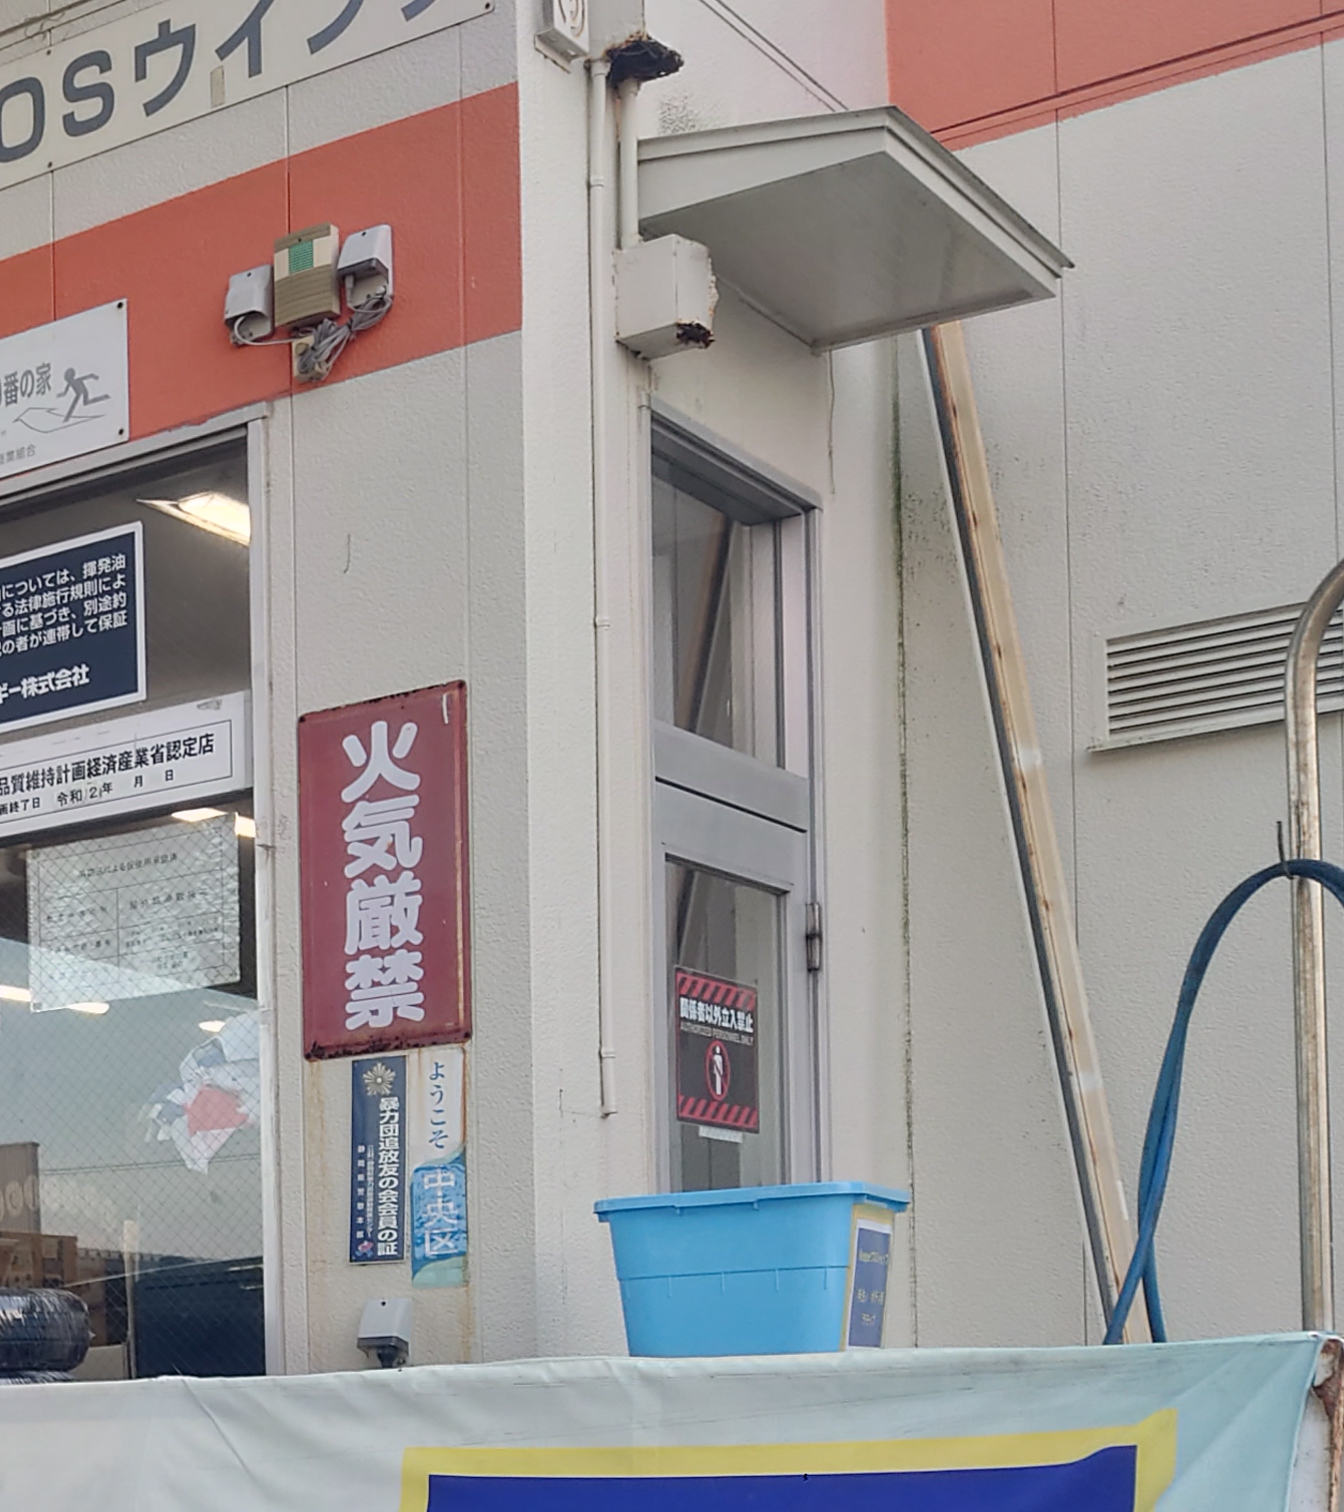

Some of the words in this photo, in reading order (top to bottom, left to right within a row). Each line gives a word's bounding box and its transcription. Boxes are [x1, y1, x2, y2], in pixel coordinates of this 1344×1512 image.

[340, 719, 425, 1032] 火気厳禁
[679, 996, 754, 1034] 関係者以外立入禁止
[428, 1061, 449, 1149] ようこそ
[377, 1097, 400, 1256] 暴力団追放友の会会員の証
[422, 1168, 459, 1257] 中央区
